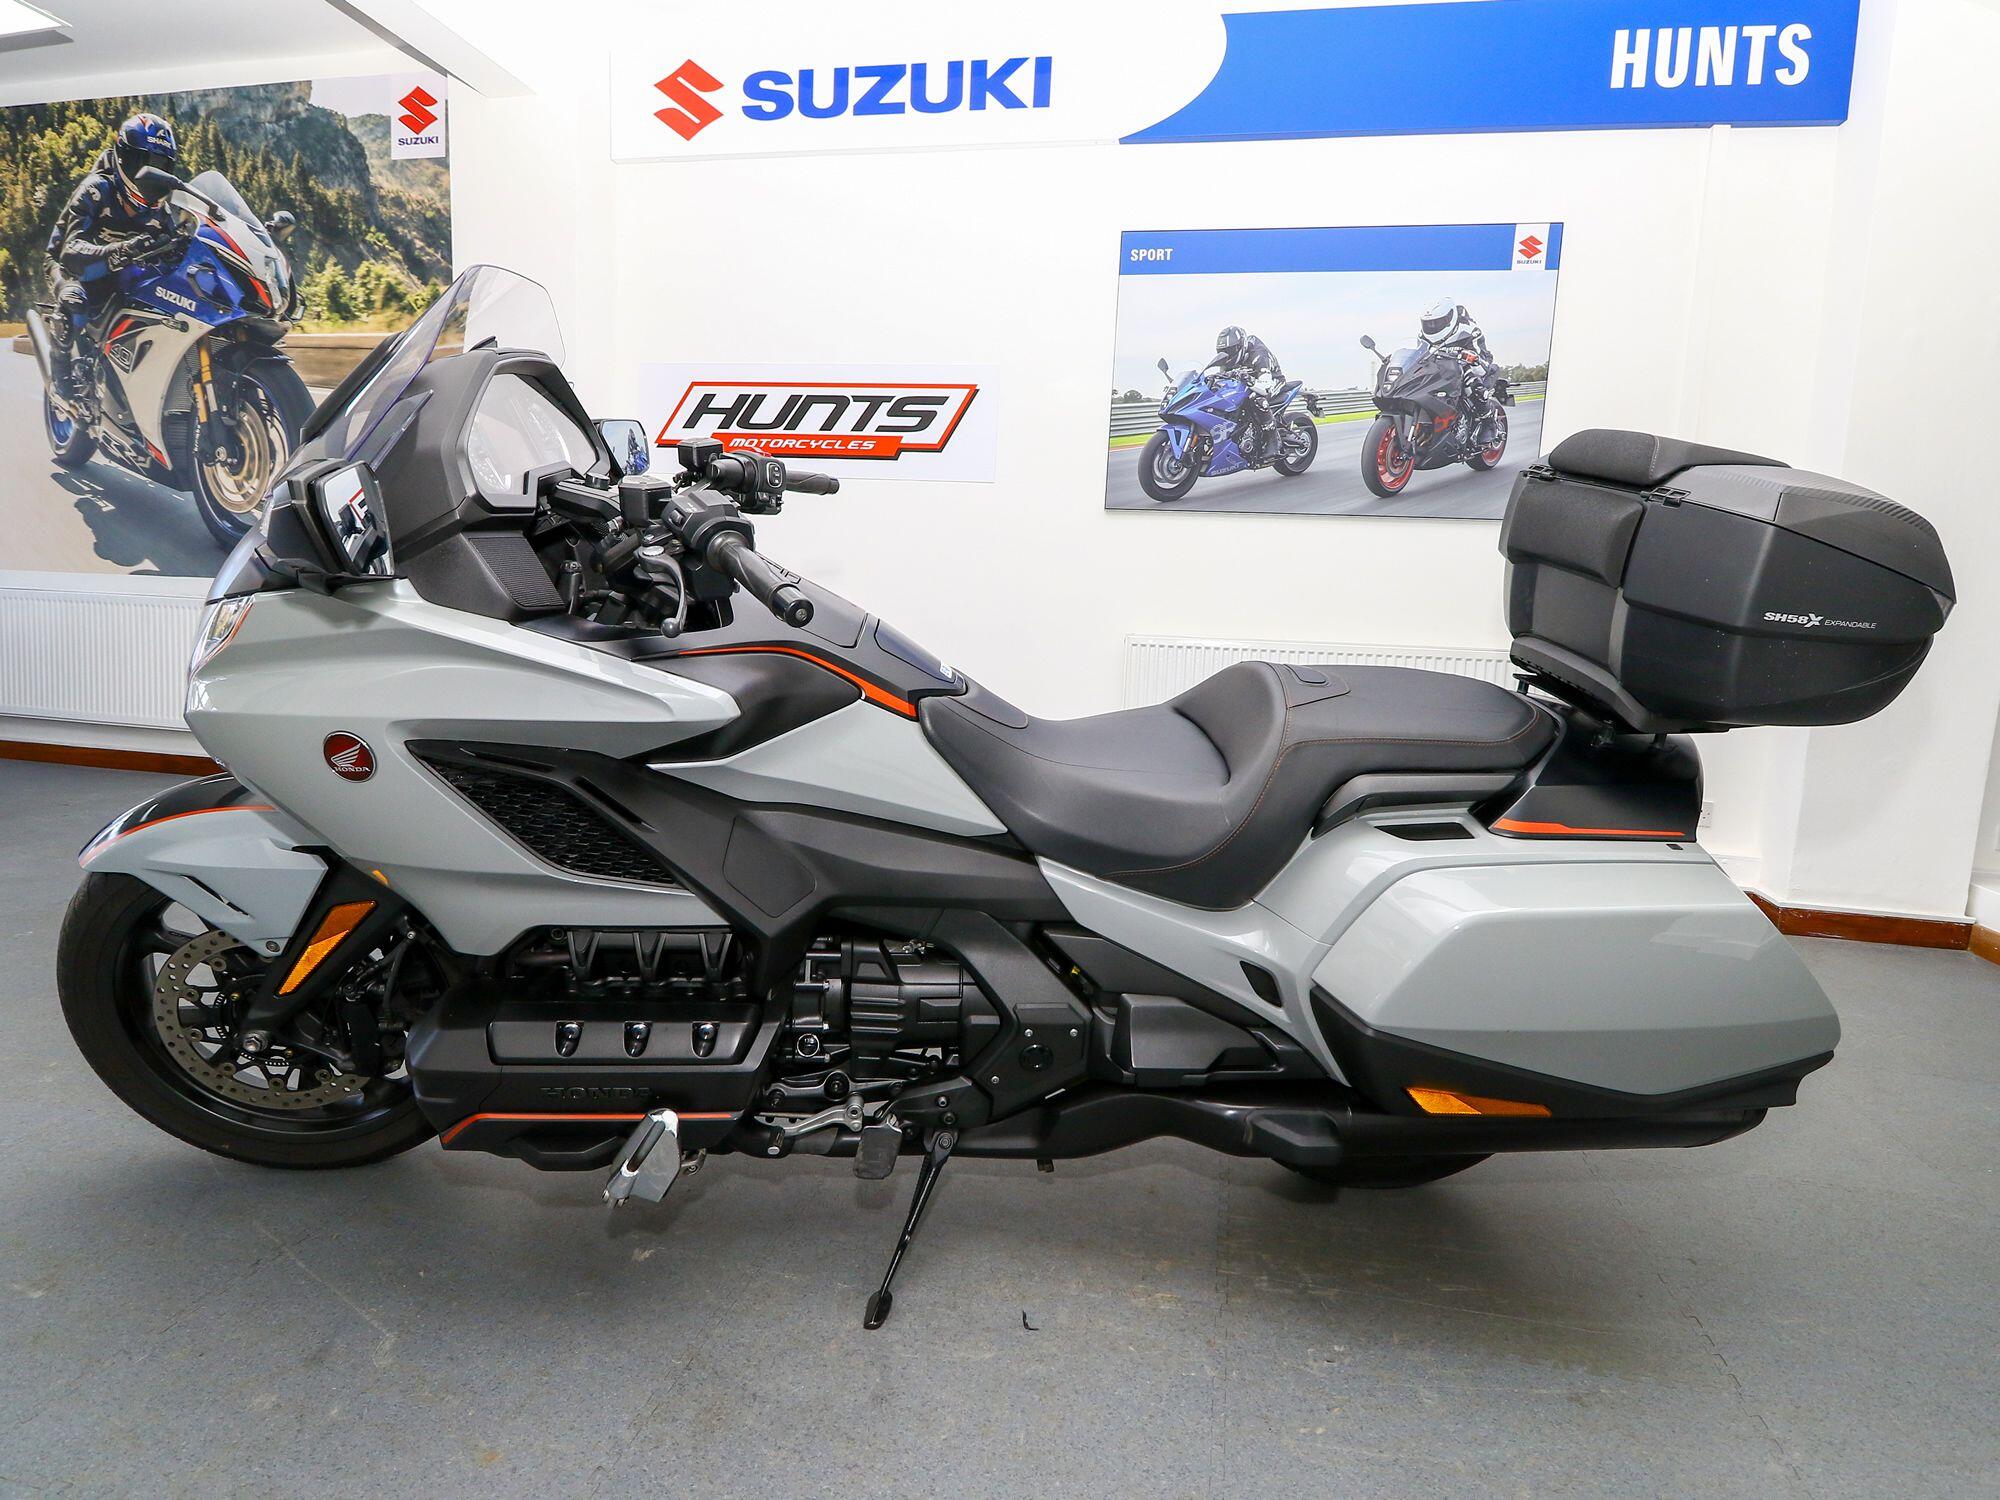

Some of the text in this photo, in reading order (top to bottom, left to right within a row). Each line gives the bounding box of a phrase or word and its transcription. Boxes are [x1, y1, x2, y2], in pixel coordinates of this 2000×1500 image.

[1610, 23, 1813, 89] HUNTS
[741, 56, 1053, 122] SUZUKI
[397, 136, 439, 146] SUZUKI
[1130, 248, 1174, 261] SPORT
[154, 286, 197, 312] SUZUKI
[682, 393, 950, 432] HUNTS
[728, 438, 877, 451] MOTORCYCLES
[1763, 611, 1877, 629] SH58X EXPANDABLE
